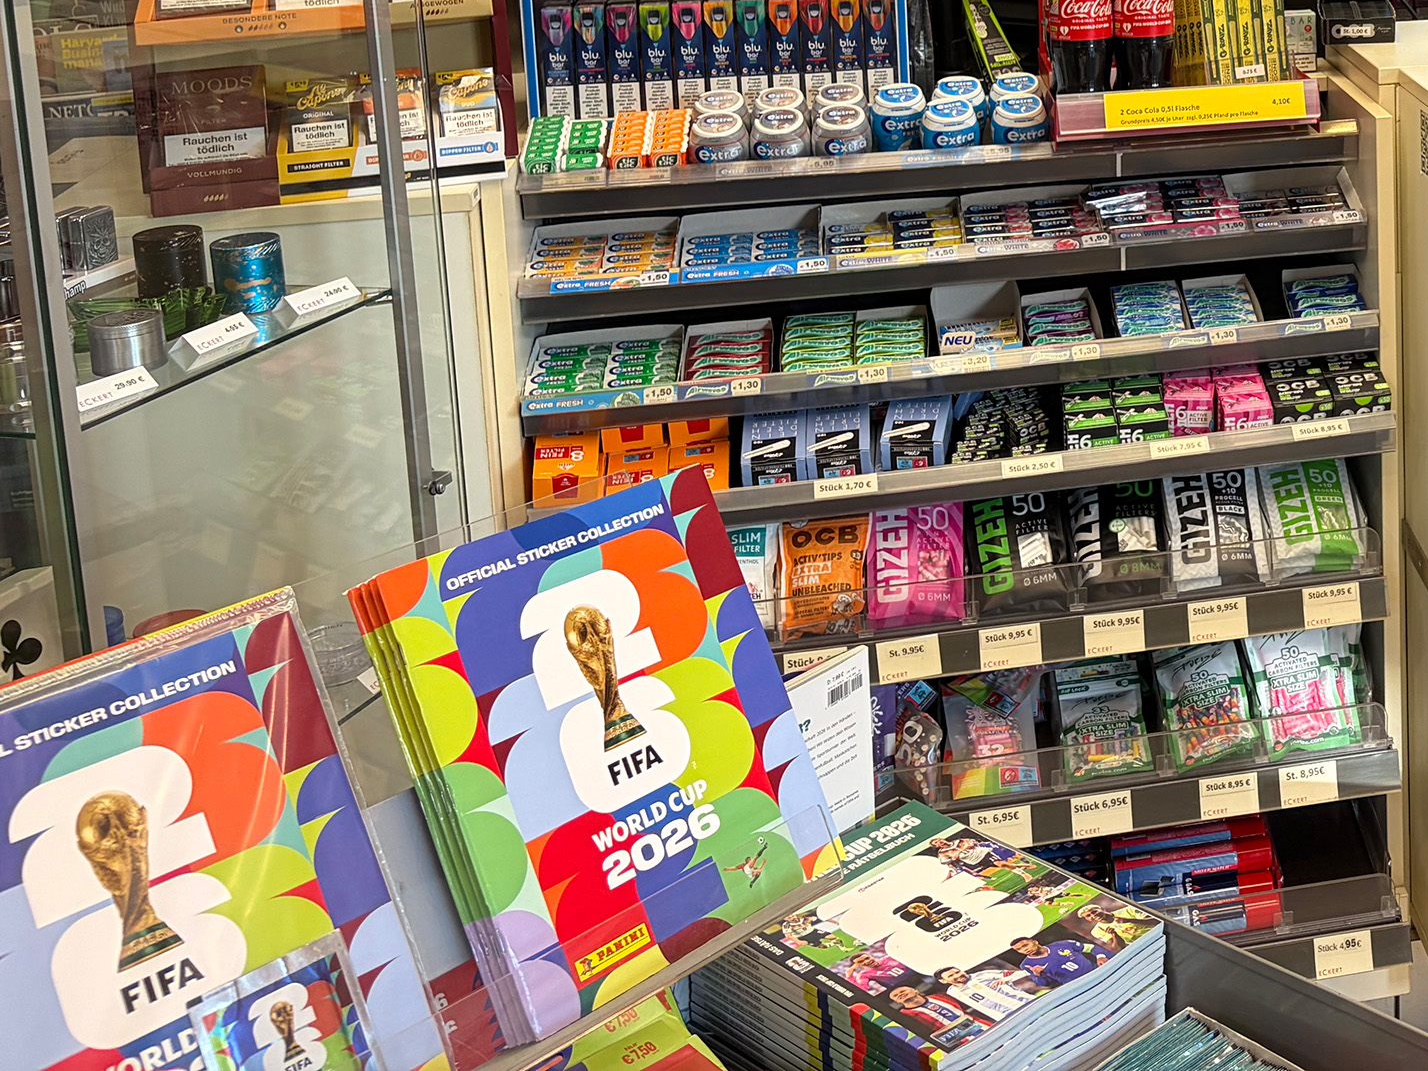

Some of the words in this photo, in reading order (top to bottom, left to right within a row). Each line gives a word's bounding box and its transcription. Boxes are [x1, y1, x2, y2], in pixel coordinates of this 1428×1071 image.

[222, 15, 269, 25] BESONDERE
[271, 13, 297, 23] NOTE
[171, 76, 253, 94] MOODS
[1120, 108, 1124, 116] 2
[1126, 106, 1143, 115] Coca
[1144, 105, 1160, 114] Cola
[1176, 103, 1200, 112] Flasche
[1272, 97, 1291, 106] 4,10€
[186, 167, 243, 178] VOLLMUNDIG
[819, 481, 843, 493] Stück
[845, 481, 864, 492] 1,70
[865, 481, 872, 489] €
[791, 524, 860, 548] OCB
[445, 557, 517, 592] OFFICIAL
[516, 534, 578, 569] STICKER
[577, 503, 666, 545] COLLECTION
[1306, 617, 1331, 626] ECKERT
[606, 743, 664, 786] FIFA
[591, 805, 655, 853] WORLD
[655, 779, 708, 822] CUP
[1074, 827, 1102, 838] ECKERT
[600, 803, 722, 891] 2026
[596, 926, 647, 962] PANINI
[1317, 943, 1338, 954] Stück
[1339, 938, 1362, 950] 4,95€
